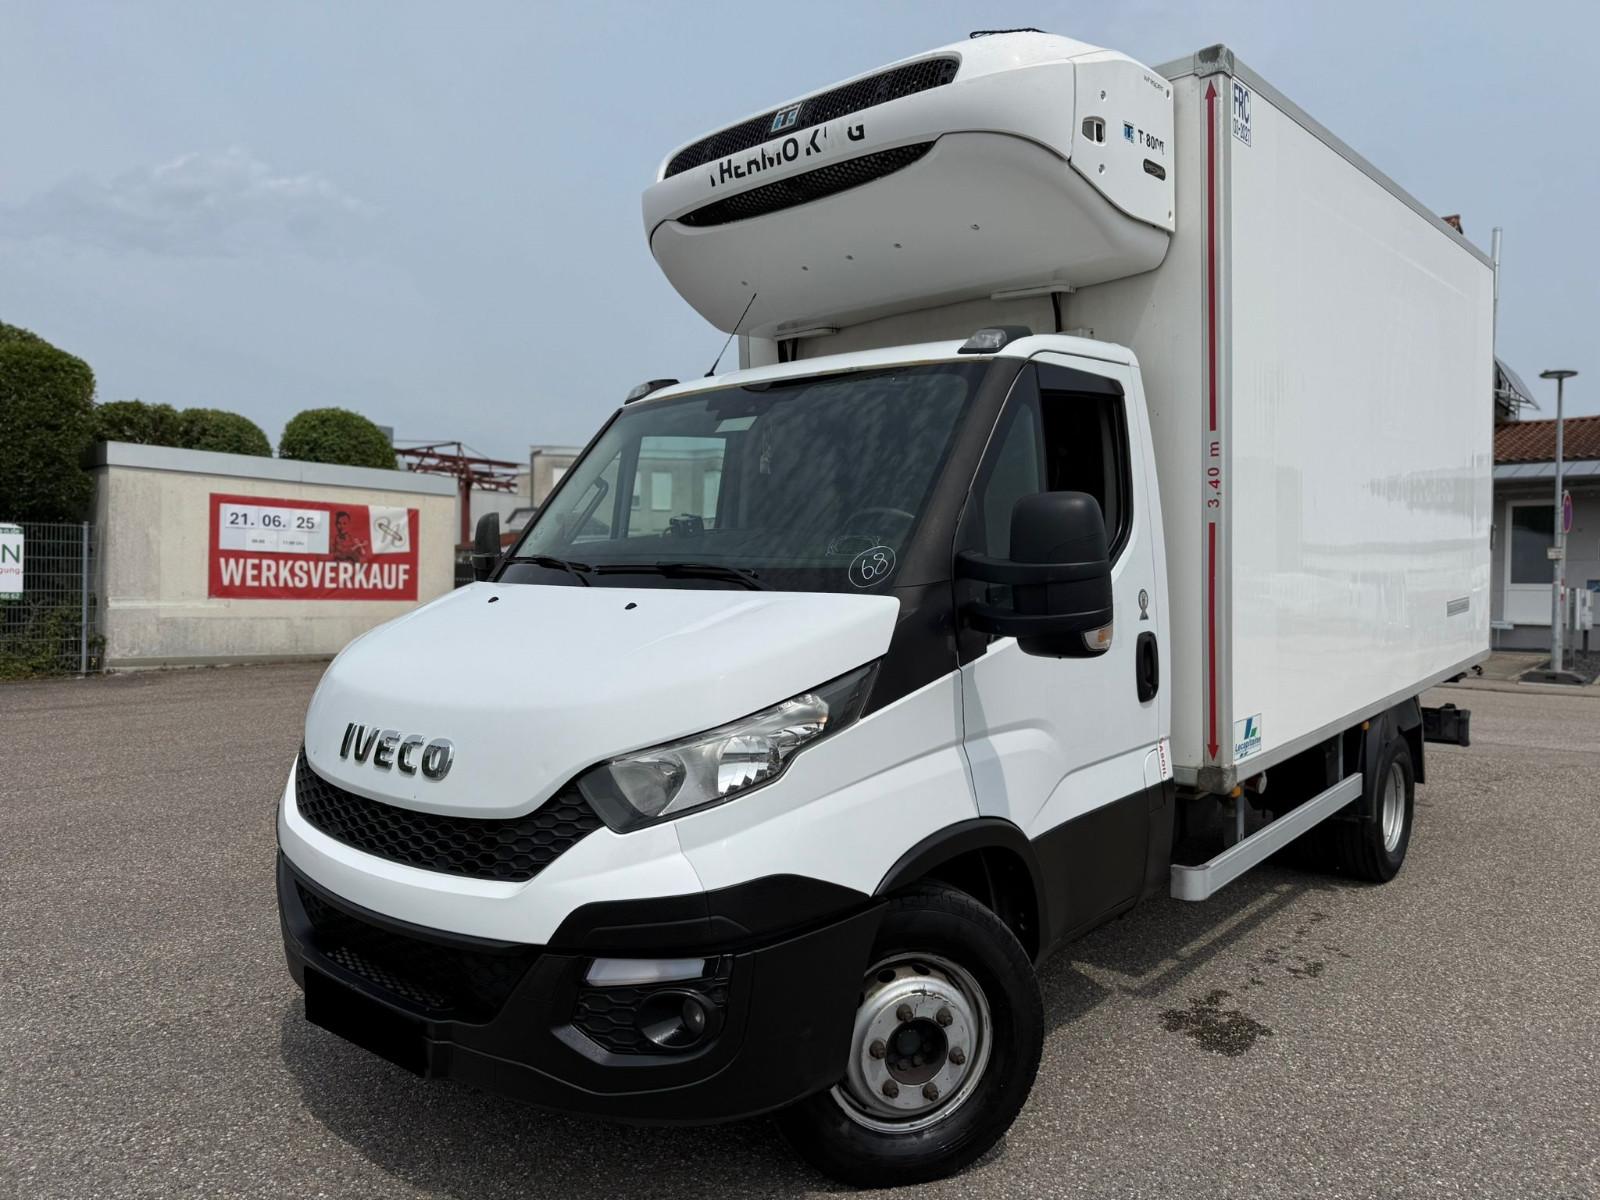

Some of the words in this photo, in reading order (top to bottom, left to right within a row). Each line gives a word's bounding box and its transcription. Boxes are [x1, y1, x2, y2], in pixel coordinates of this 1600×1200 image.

[1233, 83, 1250, 124] FRC
[1209, 441, 1220, 457] m
[1207, 467, 1221, 508] 3,40
[229, 512, 255, 527] 21.
[262, 514, 287, 529] 06.
[296, 516, 315, 531] 25
[219, 557, 410, 591] WERKSVERKAUF
[861, 552, 889, 580] 68
[339, 720, 456, 781] IVECO
